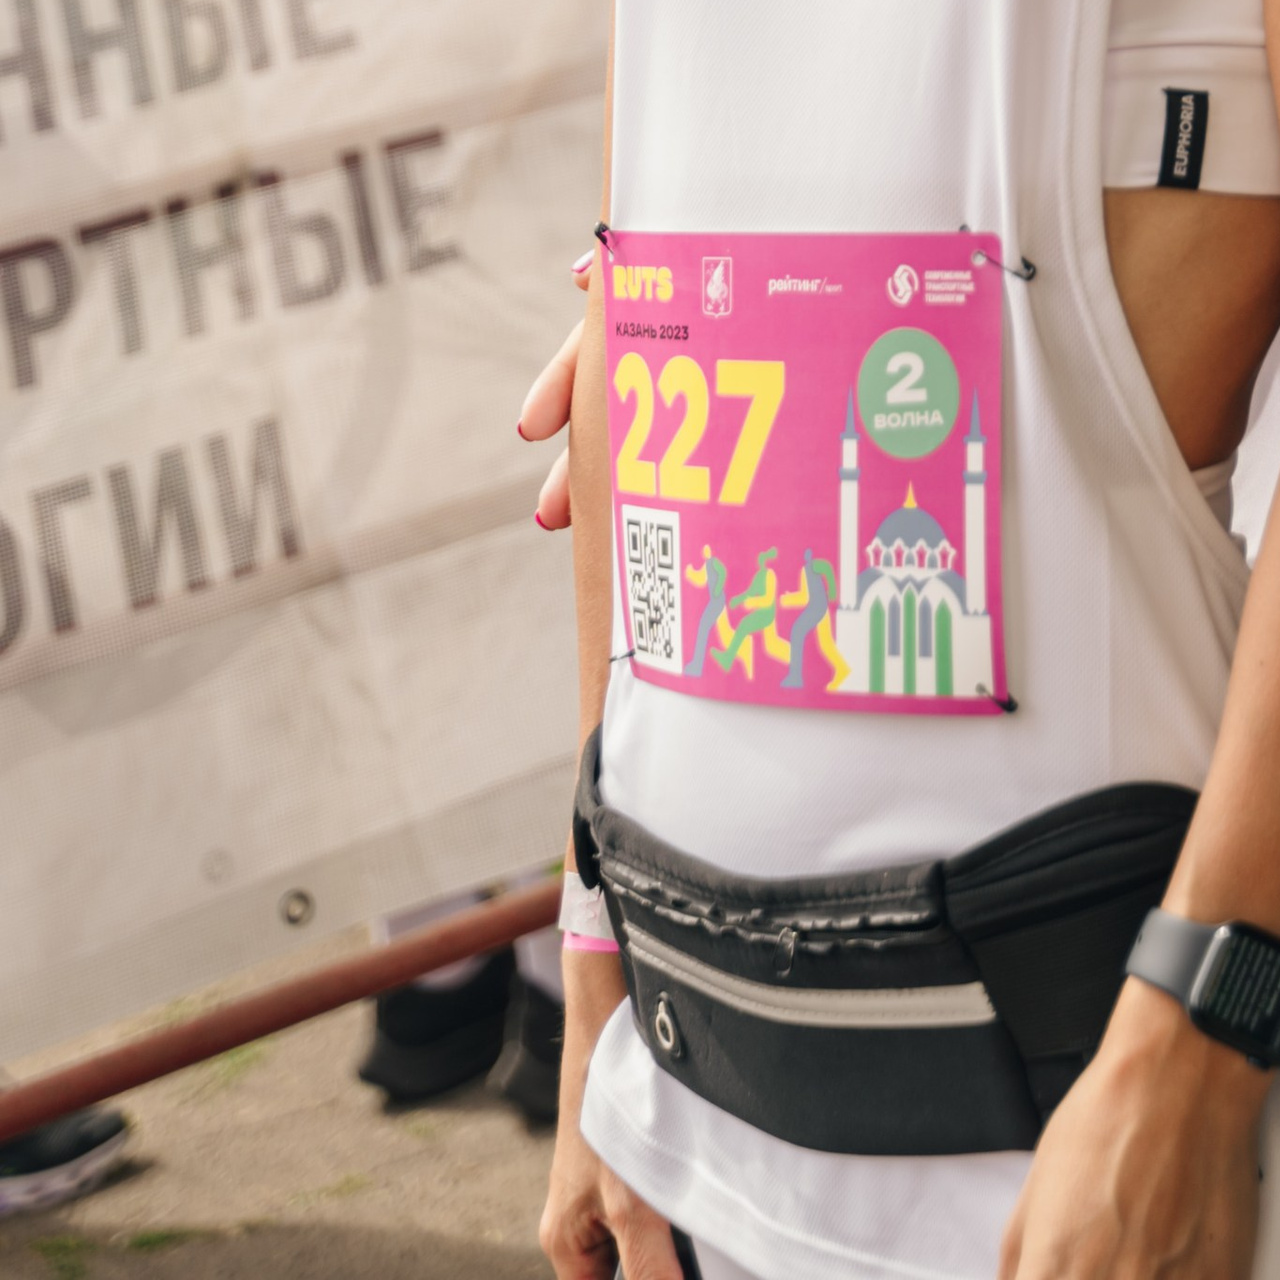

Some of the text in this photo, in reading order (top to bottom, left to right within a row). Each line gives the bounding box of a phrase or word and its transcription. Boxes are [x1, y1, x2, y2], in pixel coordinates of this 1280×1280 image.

[1173, 94, 1195, 176] EUPHORIA
[613, 265, 674, 303] RUTS
[616, 322, 689, 340] КАЗАНЬ 2023
[886, 351, 927, 405] 2
[613, 352, 786, 506] 227
[874, 410, 945, 431] ВОЛНА
